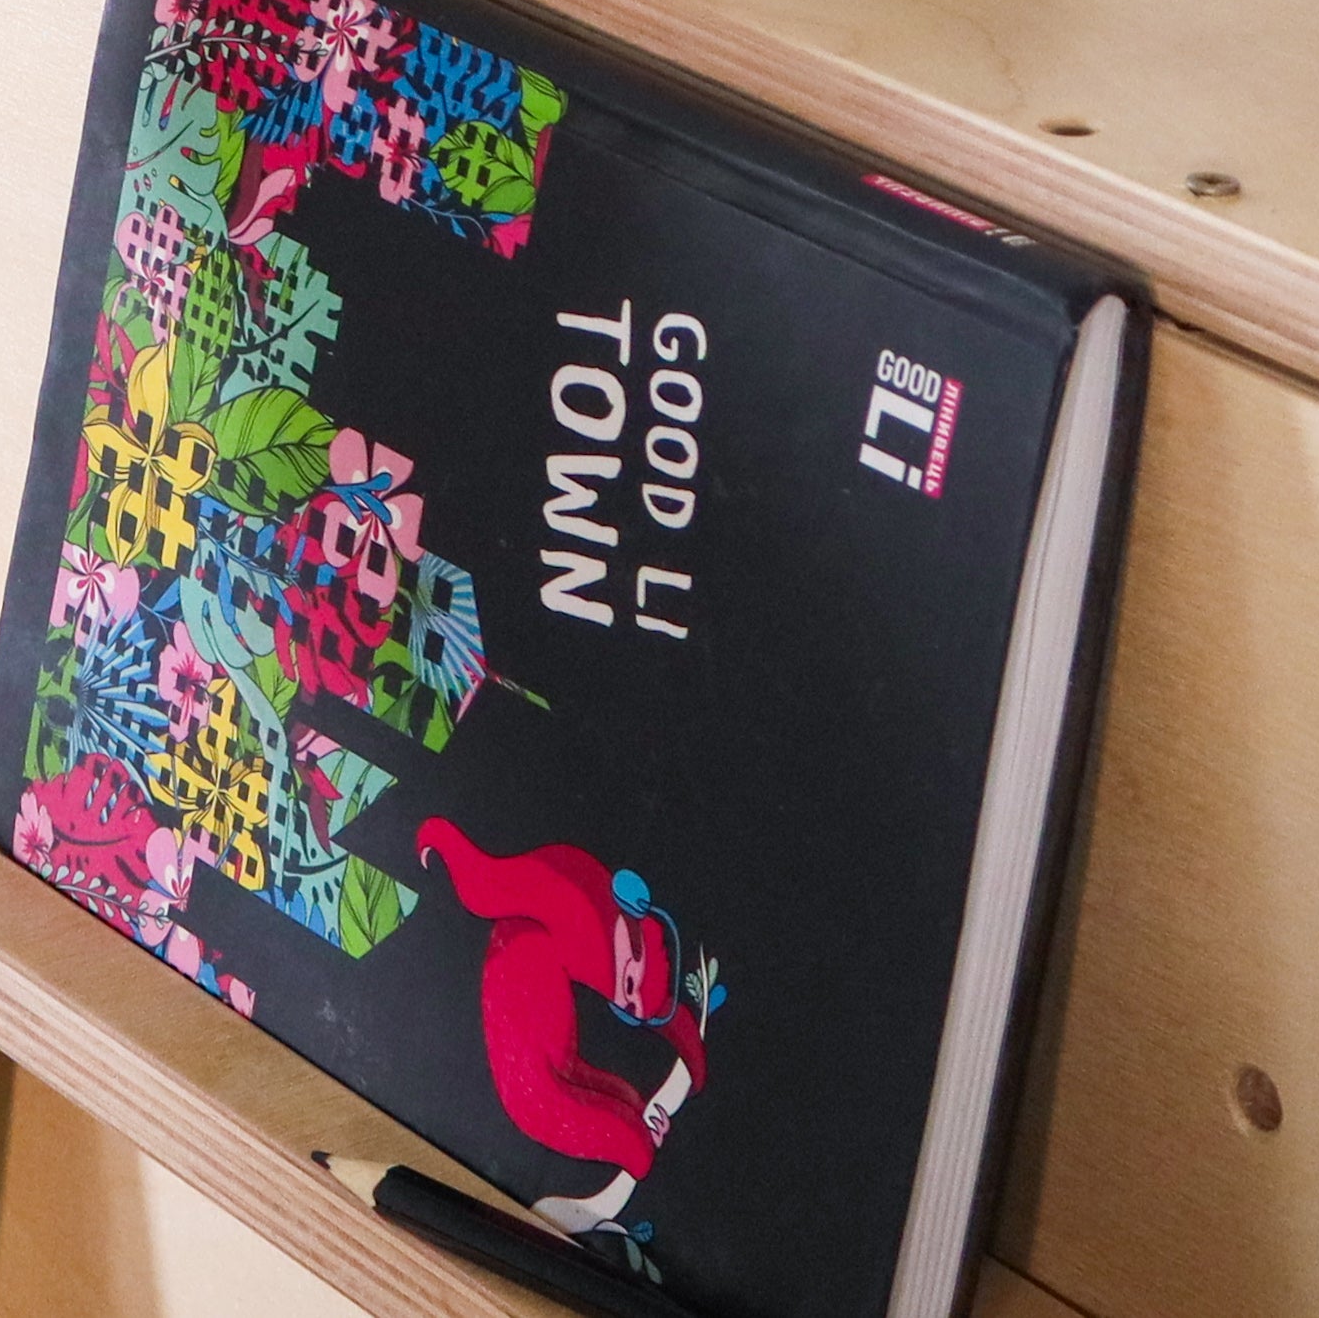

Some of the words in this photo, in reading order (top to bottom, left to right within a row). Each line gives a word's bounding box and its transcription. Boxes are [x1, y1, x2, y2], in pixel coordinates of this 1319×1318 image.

[641, 313, 707, 529] GOOD
[876, 348, 941, 404] GOOD
[539, 298, 631, 627] TOWN
[924, 380, 960, 495] ЛІНИВЕЦЬ
[635, 566, 692, 640] LI
